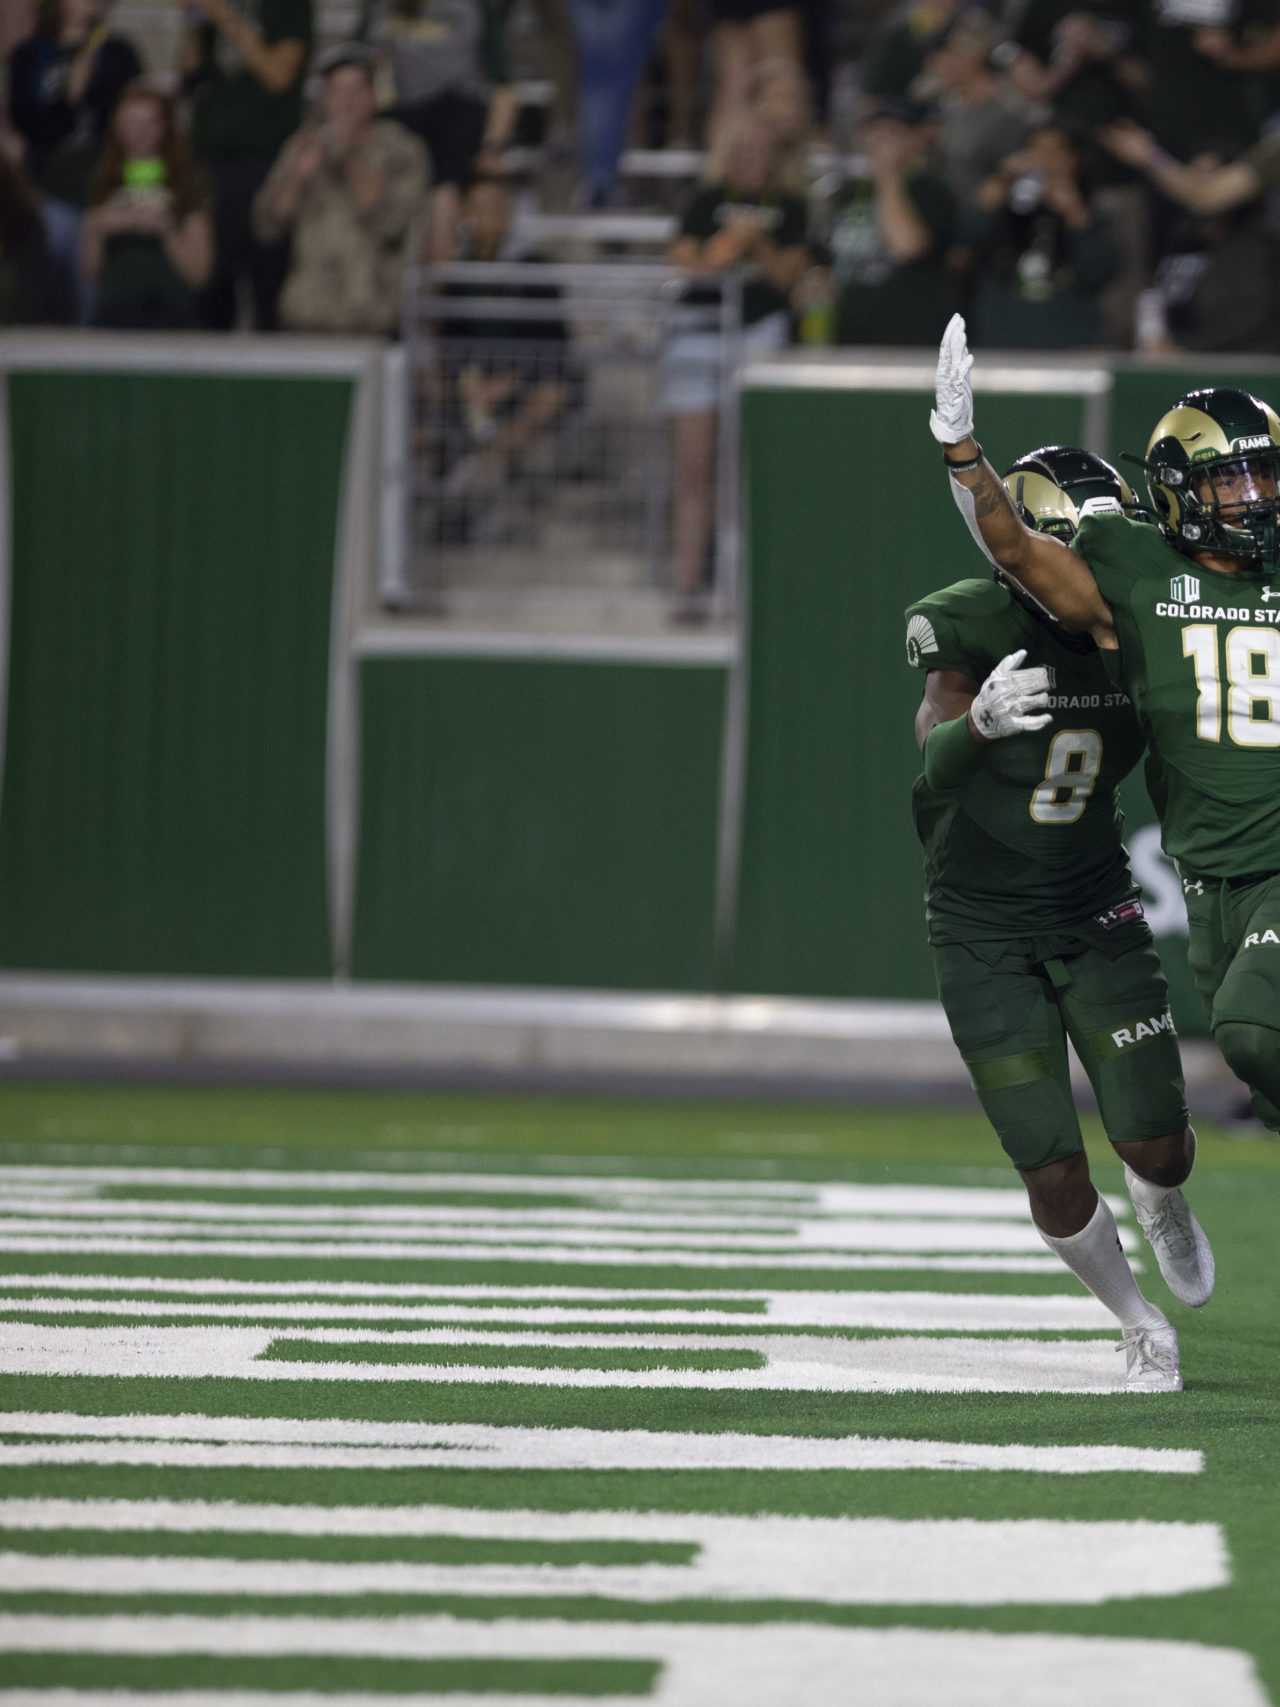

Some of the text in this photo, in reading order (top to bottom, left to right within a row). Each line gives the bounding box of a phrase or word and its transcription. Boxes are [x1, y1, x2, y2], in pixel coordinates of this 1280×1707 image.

[1239, 436, 1271, 450] RAMS
[1155, 602, 1250, 622] COLORADO
[1047, 692, 1132, 709] ORADO STA
[1029, 728, 1104, 824] 8
